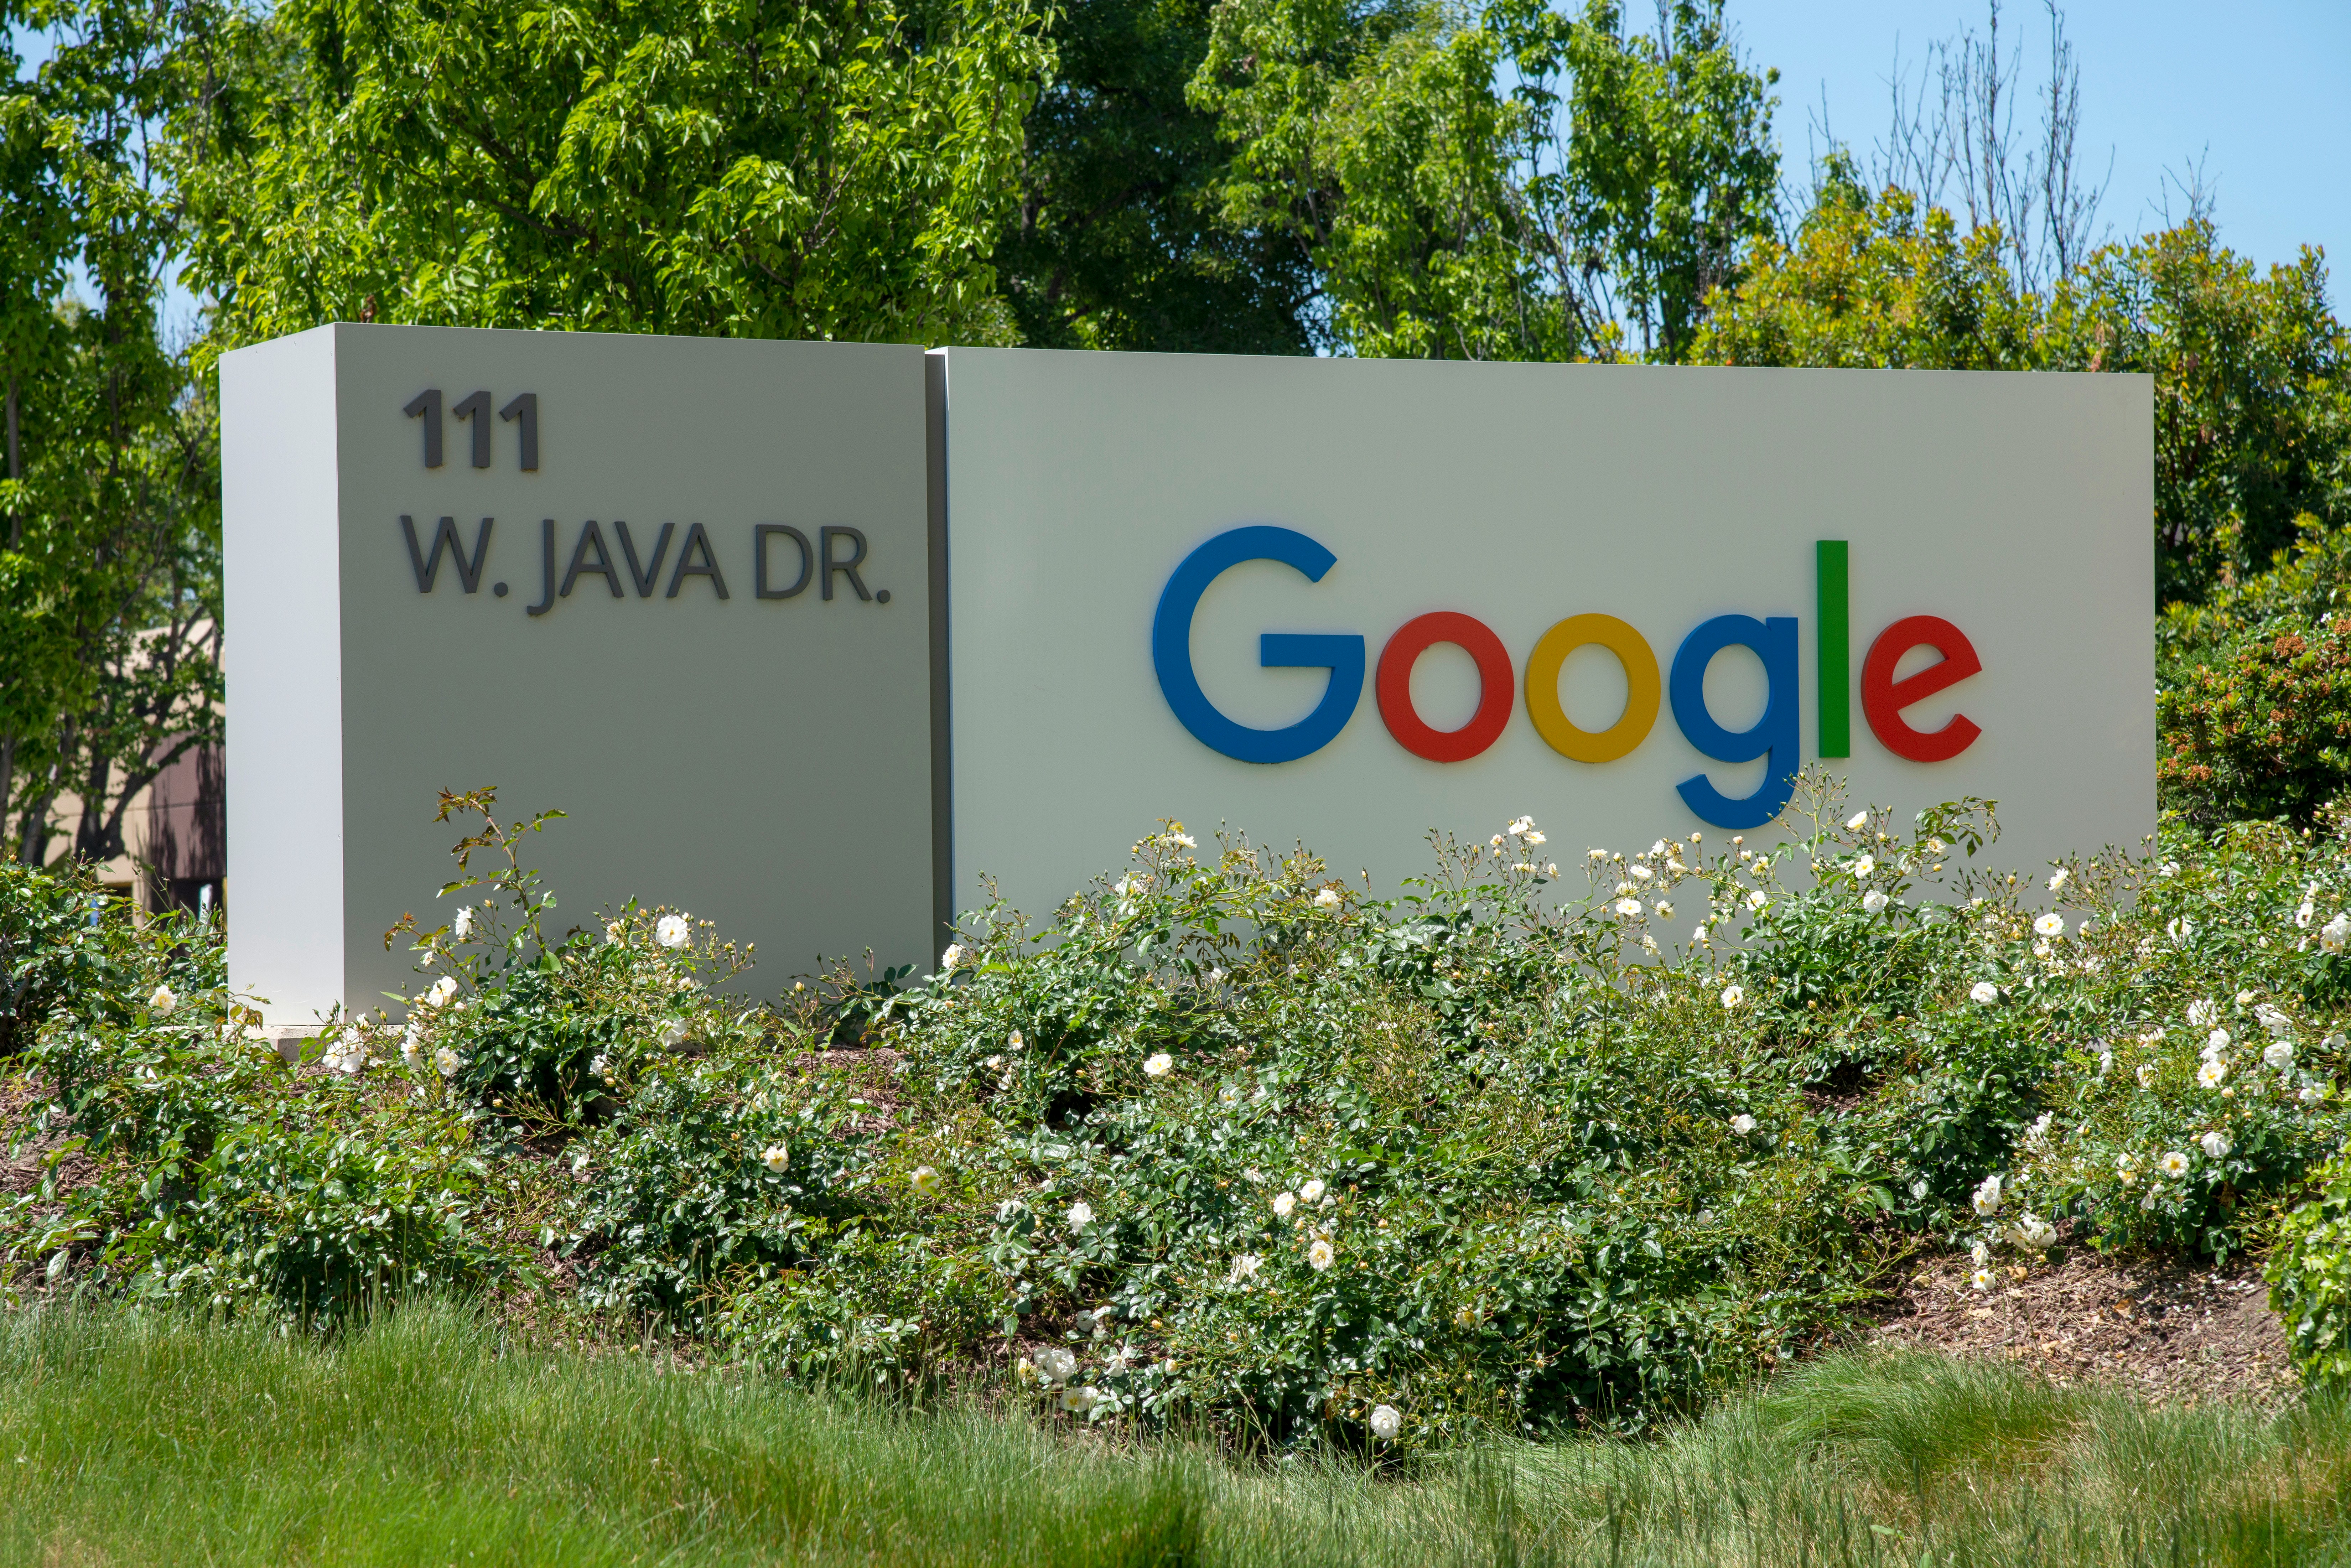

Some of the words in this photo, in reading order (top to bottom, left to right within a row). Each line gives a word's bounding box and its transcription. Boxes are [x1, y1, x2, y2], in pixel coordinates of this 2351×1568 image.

[403, 389, 538, 471] 111
[400, 515, 508, 597] W.
[527, 519, 730, 616] JAVA
[756, 524, 891, 604] DR.
[1152, 525, 1983, 829] Google
